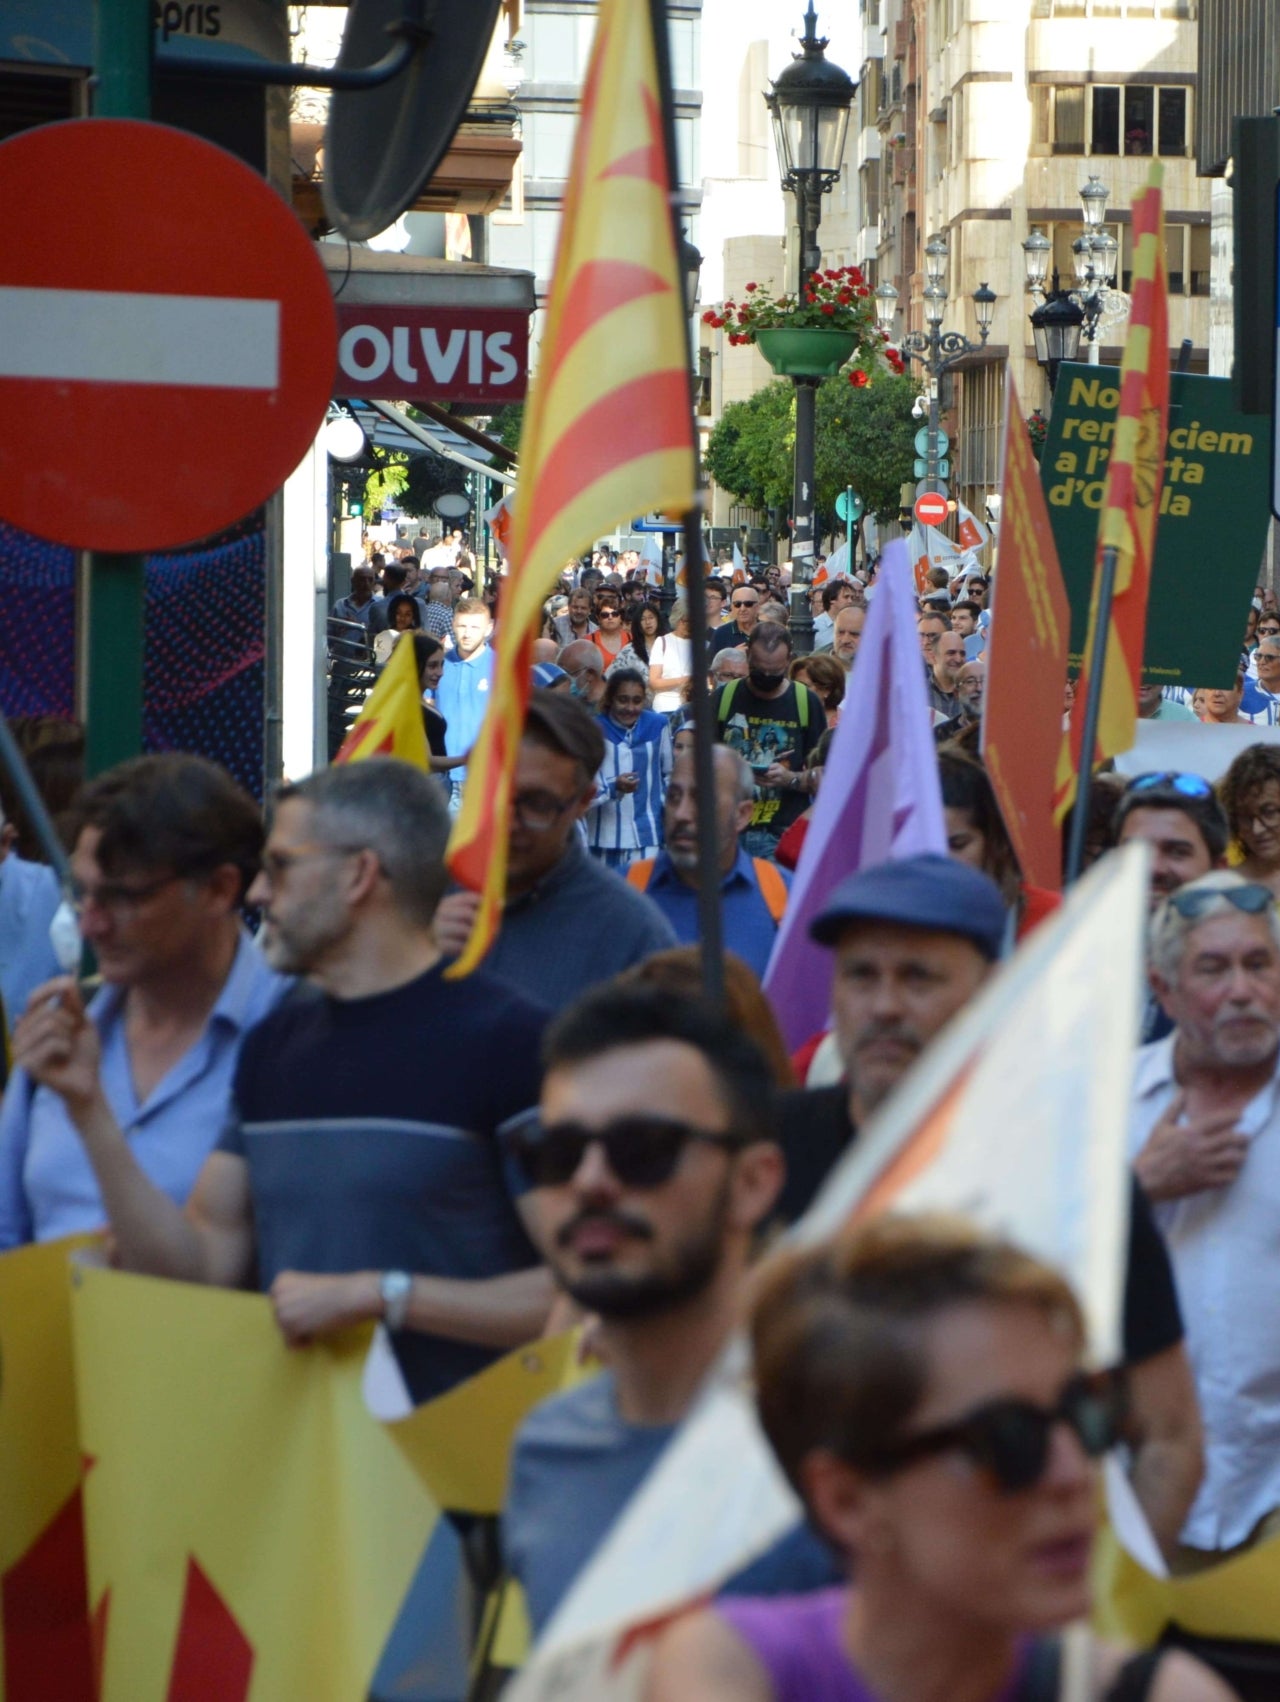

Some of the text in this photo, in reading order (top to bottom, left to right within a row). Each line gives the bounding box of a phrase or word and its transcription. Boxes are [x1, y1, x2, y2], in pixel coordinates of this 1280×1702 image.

[1068, 378, 1120, 409] No
[1062, 418, 1253, 454] renciem
[1055, 451, 1077, 473] a
